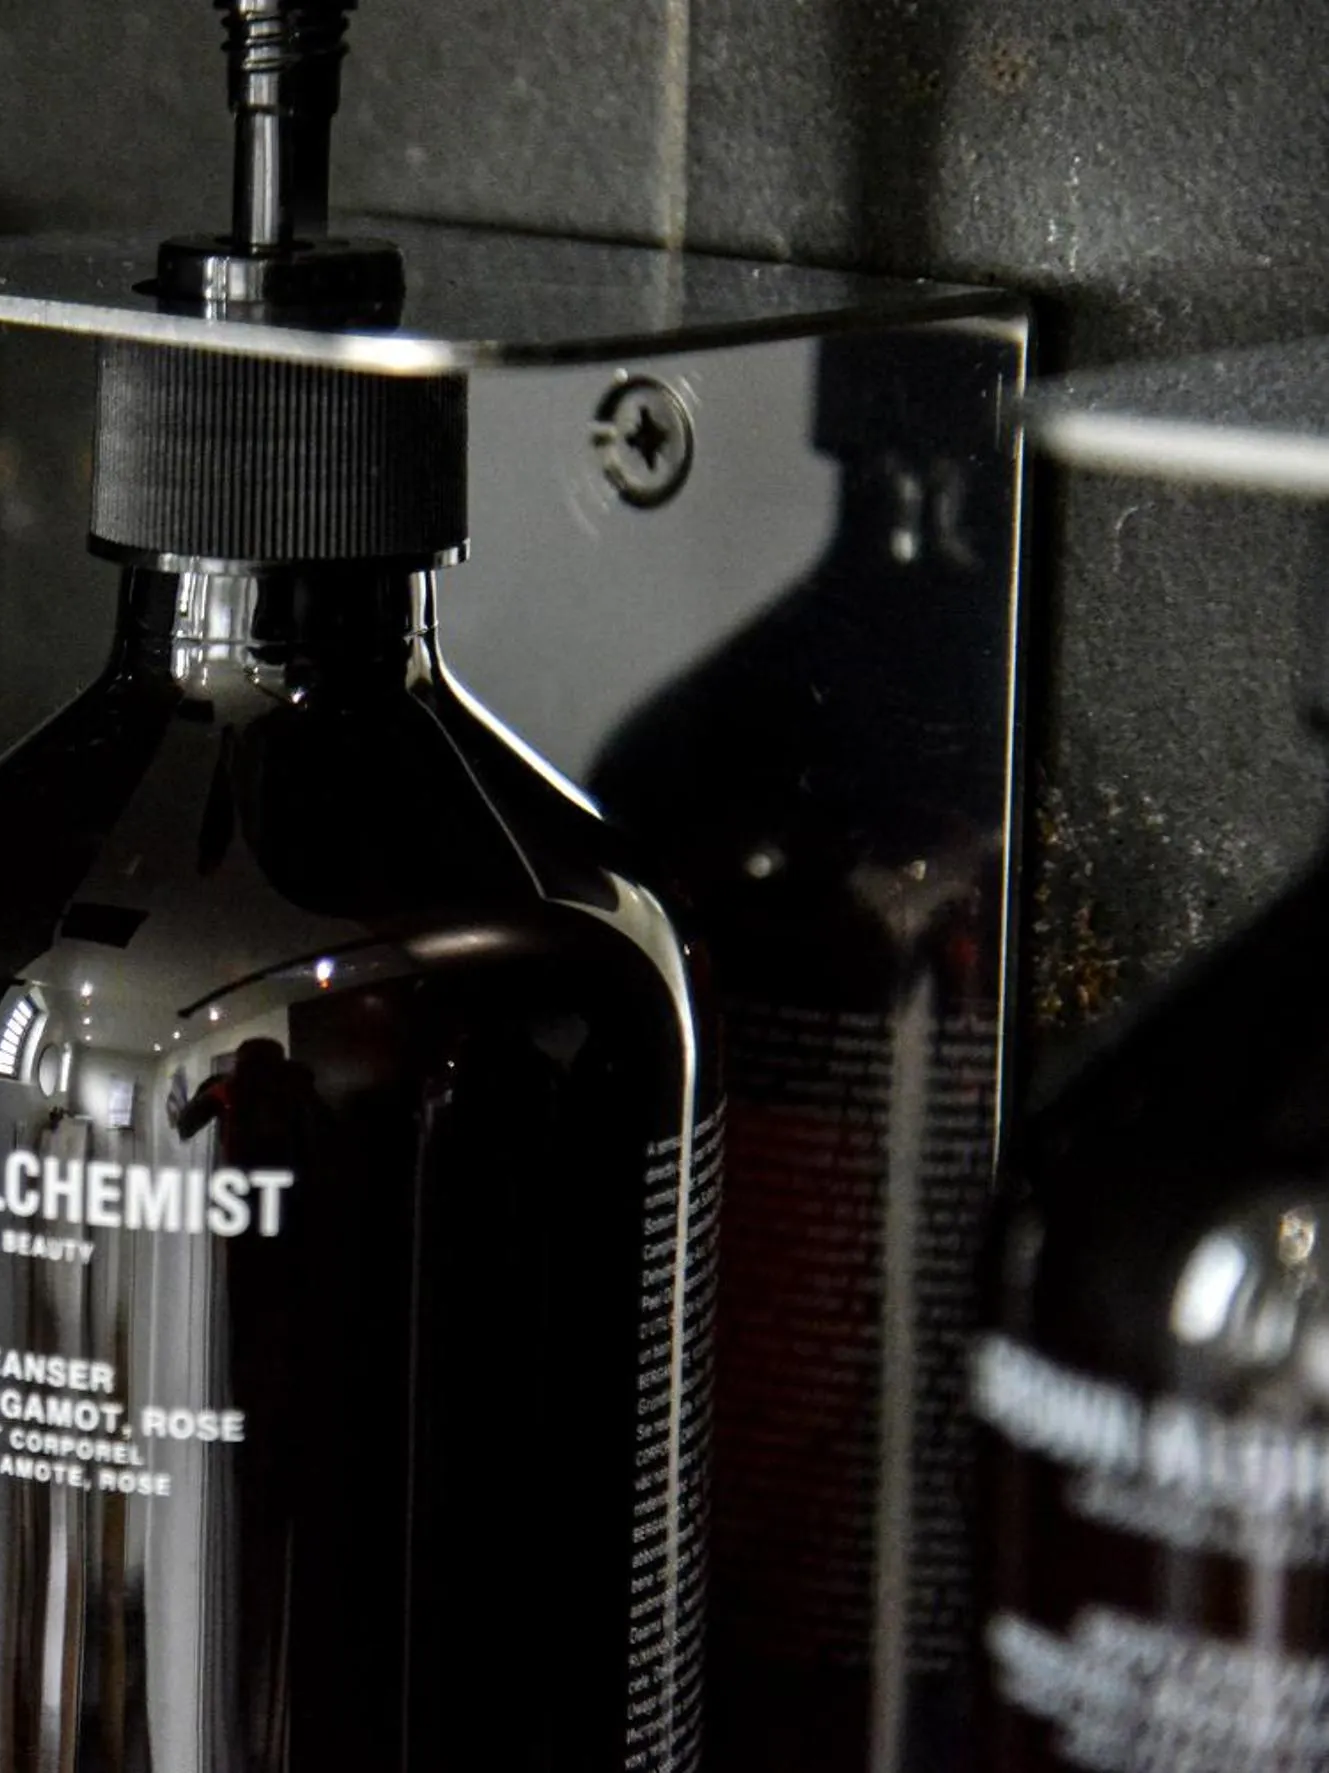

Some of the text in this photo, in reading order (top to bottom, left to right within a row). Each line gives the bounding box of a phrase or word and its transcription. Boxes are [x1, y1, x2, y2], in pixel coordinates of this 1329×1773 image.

[1, 1229, 95, 1265] BEAUTY
[142, 1405, 247, 1443] ROSE
[8, 1429, 146, 1466] CORPOREL
[98, 1468, 172, 1497] ROSE
